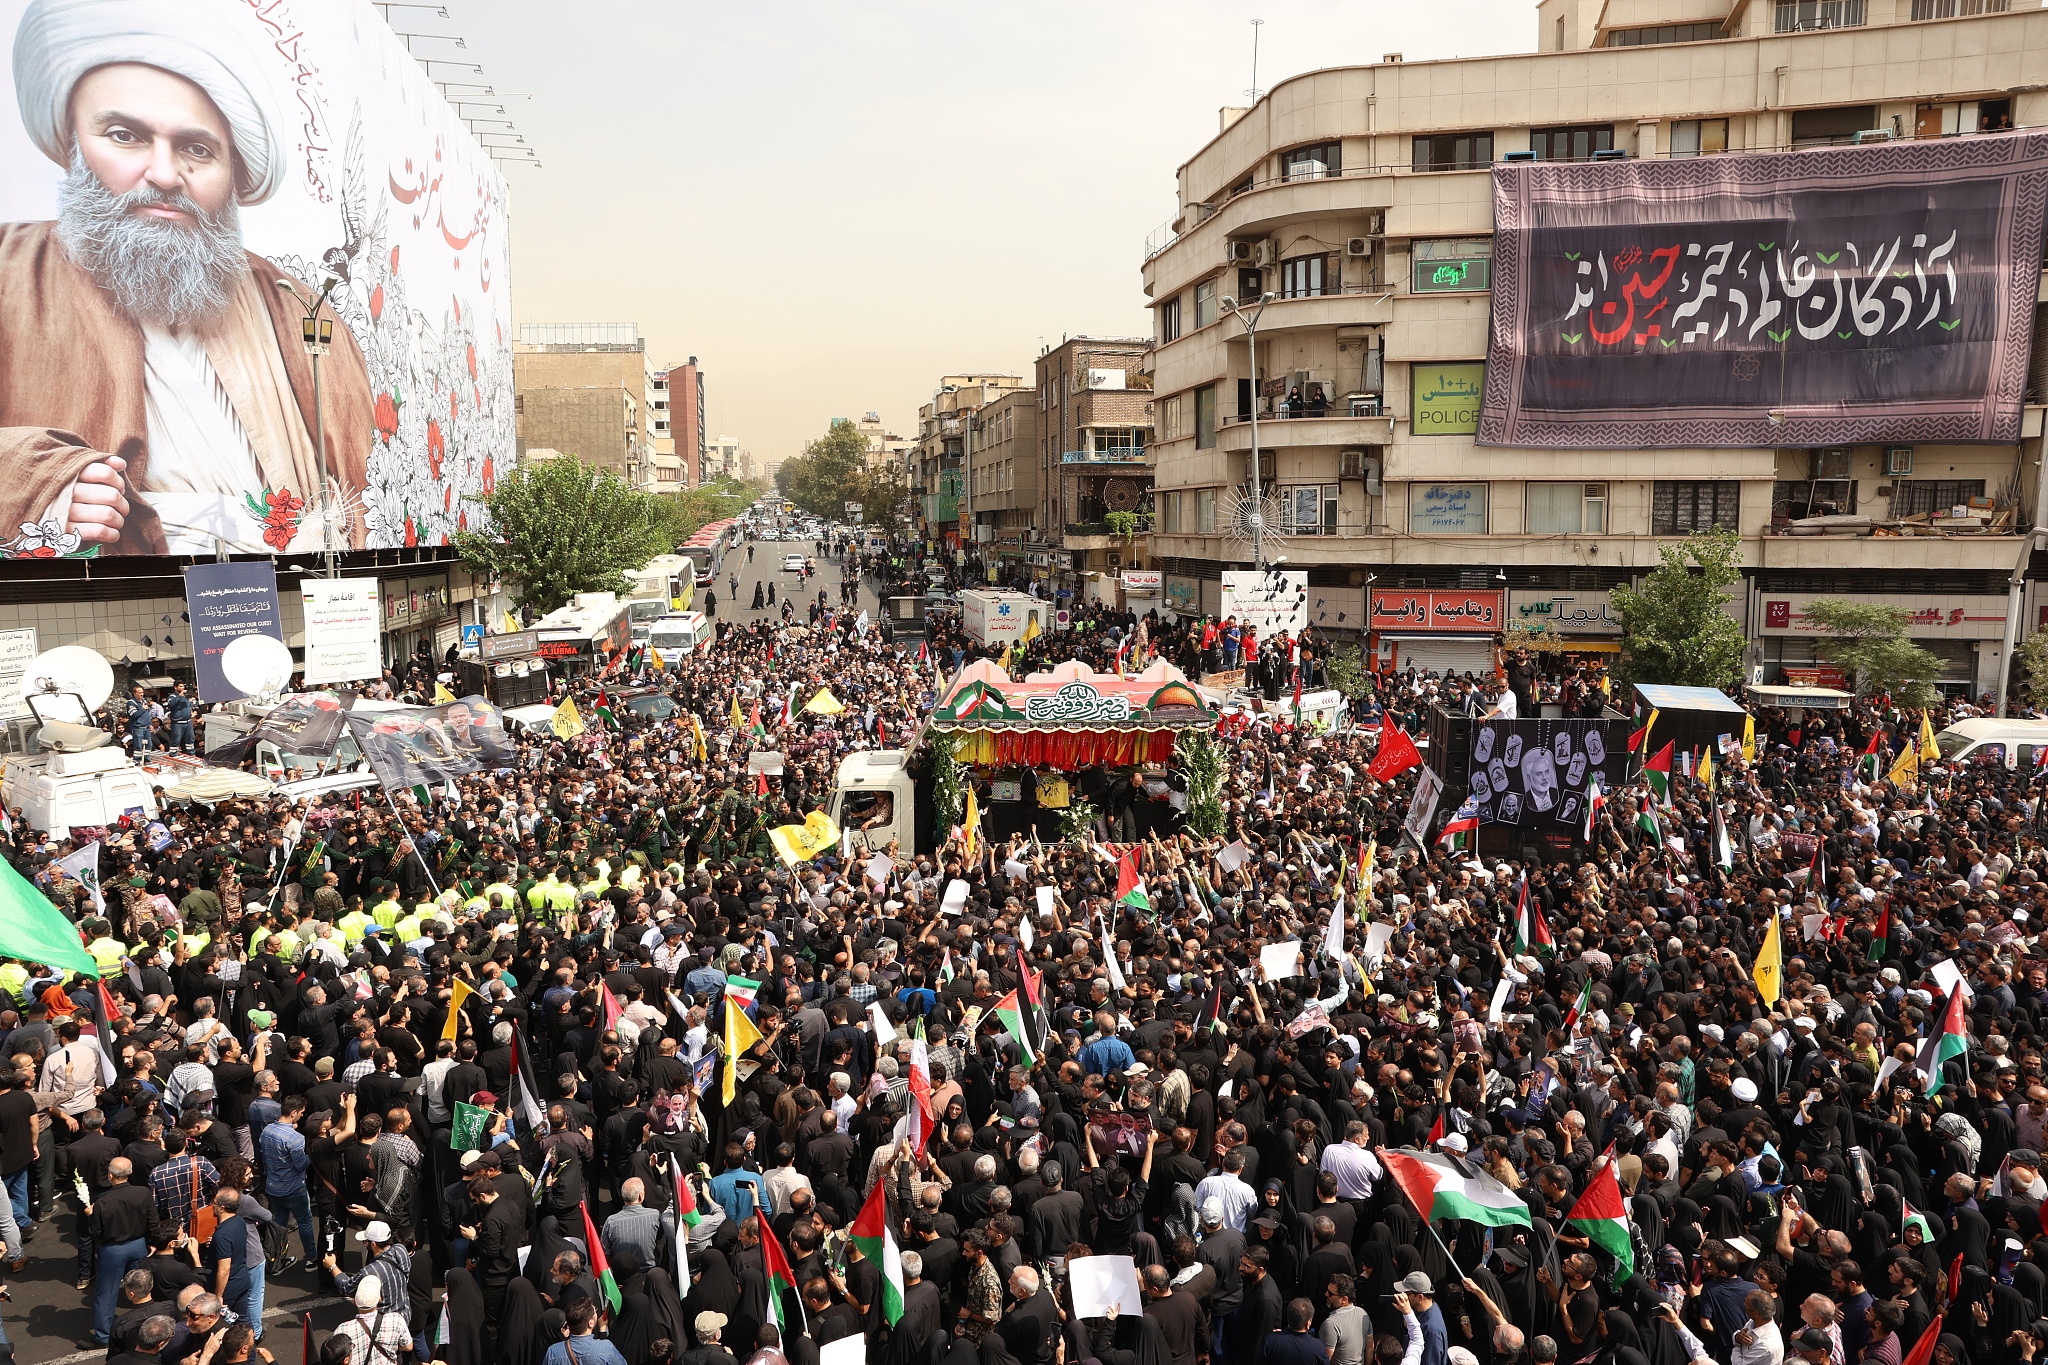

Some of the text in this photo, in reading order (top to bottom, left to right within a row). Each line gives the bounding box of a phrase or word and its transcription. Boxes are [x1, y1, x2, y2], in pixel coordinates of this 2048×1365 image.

[1422, 382, 1482, 402] پلیس
[1420, 410, 1480, 424] POLICE
[1424, 487, 1471, 503] دفترخانه
[1144, 576, 1158, 584] خانه
[1374, 598, 1426, 622] وانیلا
[1434, 599, 1494, 622] ویتامینه
[1520, 602, 1554, 618] کلاب
[6, 644, 24, 652] آزادی
